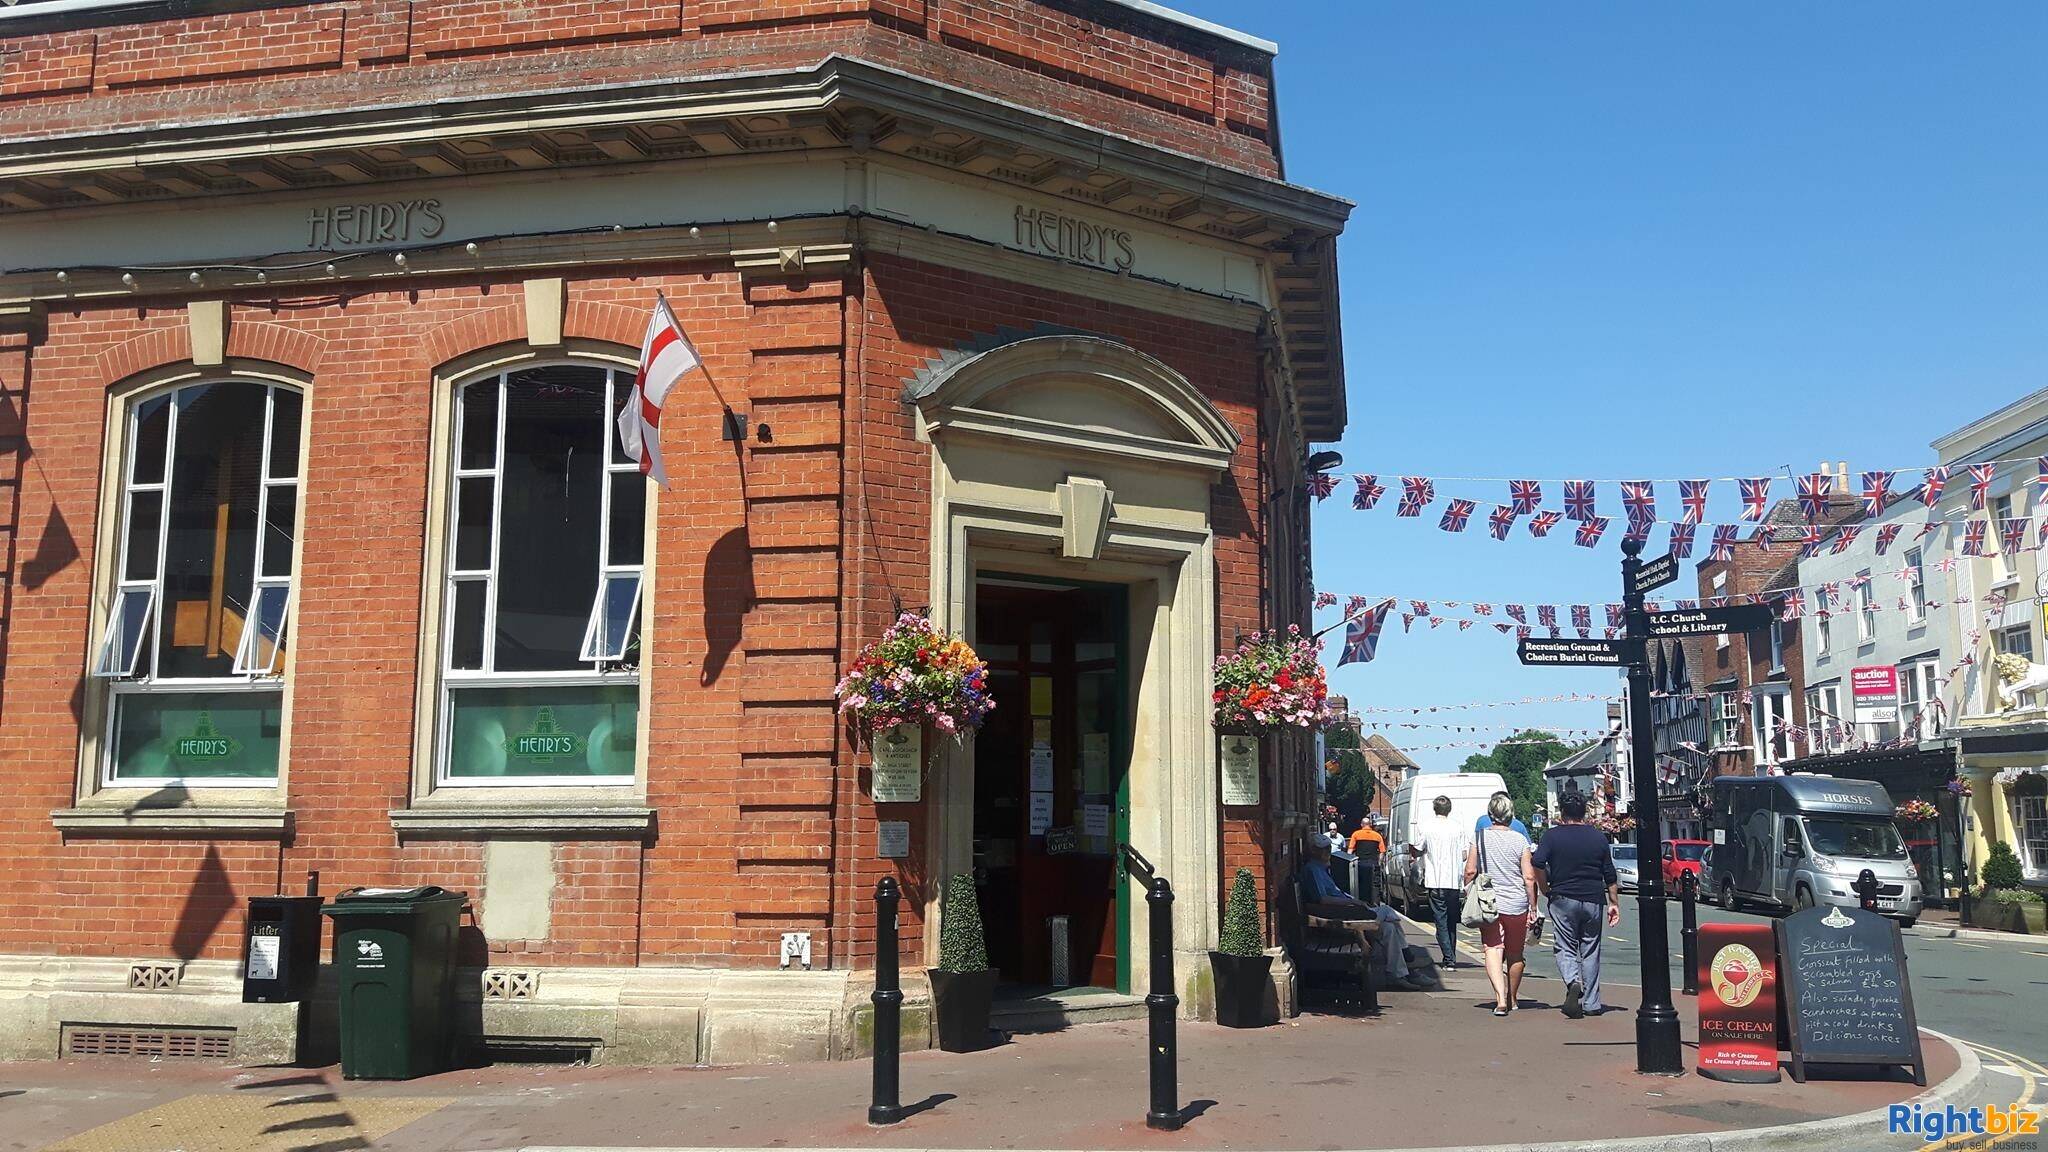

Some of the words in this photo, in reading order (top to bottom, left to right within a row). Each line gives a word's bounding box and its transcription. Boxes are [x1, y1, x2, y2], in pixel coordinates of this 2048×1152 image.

[307, 199, 445, 247] HENRY'S
[1014, 204, 1136, 270] HENRY'S
[1649, 614, 1670, 624] R.C.
[1671, 612, 1707, 623] Church
[1649, 625, 1680, 635] School
[1681, 625, 1690, 633] &
[1690, 623, 1727, 632] Library
[1525, 642, 1570, 651] Recreation
[1570, 642, 1602, 652] Ground
[1602, 643, 1611, 652] &
[1525, 652, 1559, 661] Cholera
[1559, 653, 1587, 662] Burial
[1588, 654, 1619, 663] Ground
[1854, 669, 1889, 679] auction
[180, 740, 227, 755] HENRY'S
[520, 737, 572, 753] HENRY'S
[1823, 793, 1873, 806] HORSES
[253, 925, 279, 937] Litter
[1801, 936, 1856, 954] Special
[1713, 951, 1726, 973] JUST
[1845, 954, 1870, 968] filled
[1801, 990, 1828, 1005] Also
[1702, 1020, 1724, 1030] ICE
[1727, 1020, 1773, 1032] CREAM
[1857, 1019, 1894, 1032] drinks
[1744, 1032, 1763, 1040] HERE
[1812, 1031, 1863, 1042] Delicious
[1868, 1033, 1900, 1044] cakes
[1735, 1058, 1742, 1066] of
[1737, 1052, 1759, 1060] Creamy
